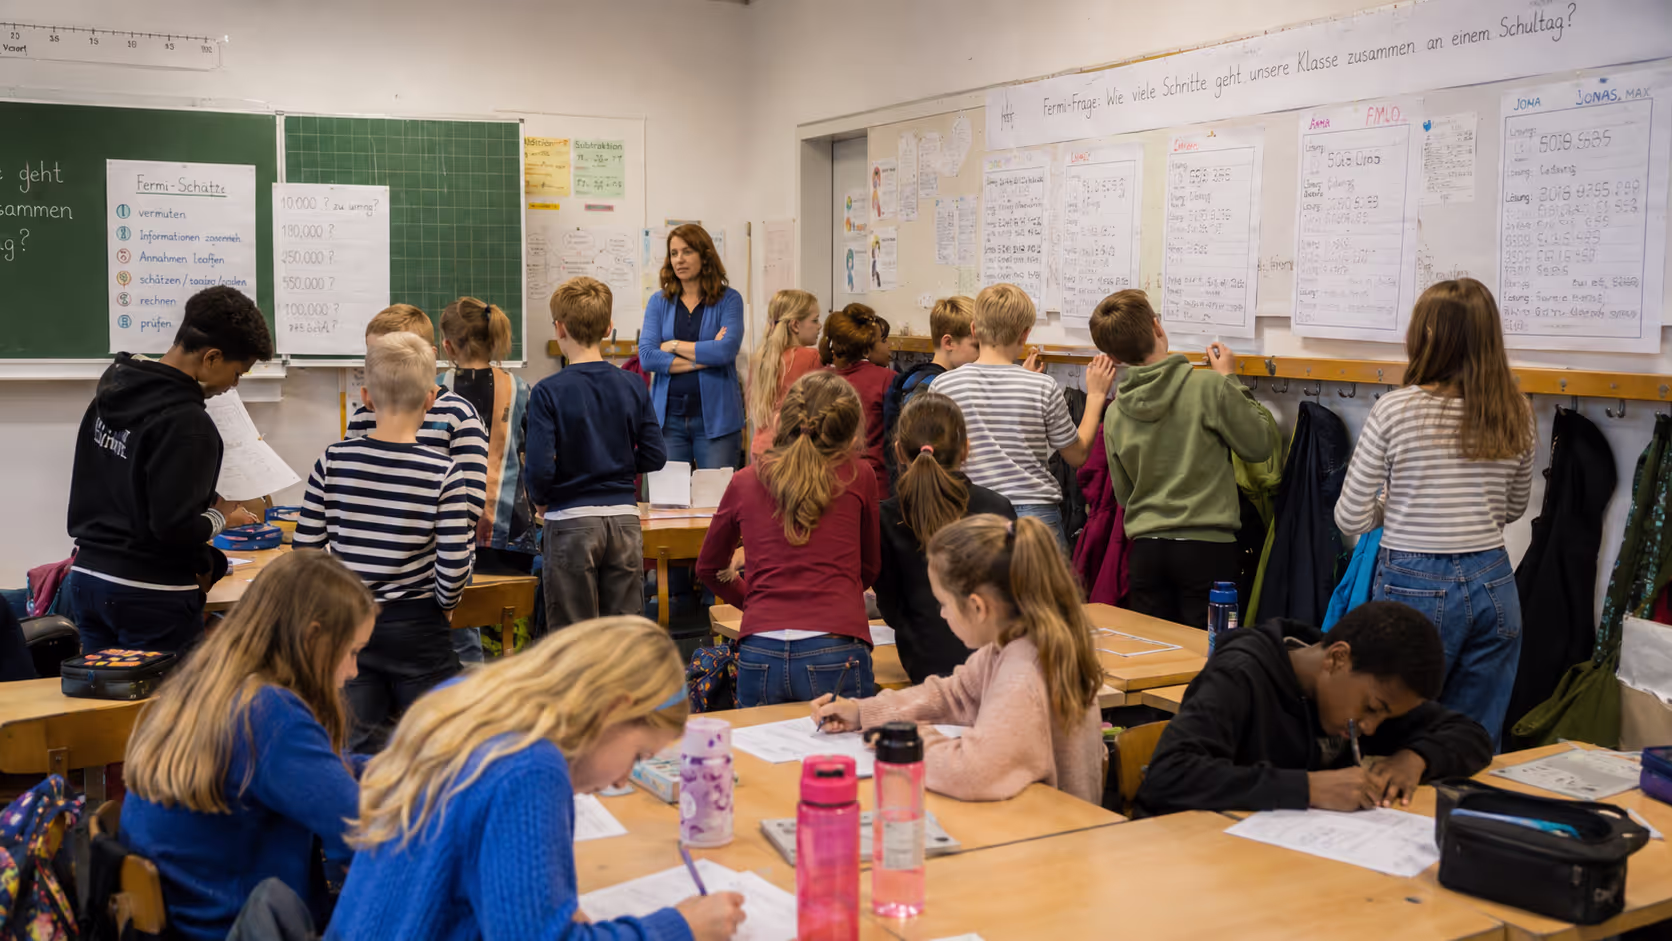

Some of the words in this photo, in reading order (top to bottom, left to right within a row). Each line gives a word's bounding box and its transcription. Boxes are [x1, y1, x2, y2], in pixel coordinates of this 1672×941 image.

[1044, 93, 1100, 119] Fermi-Frage:
[1106, 87, 1124, 106] Wie
[1132, 81, 1156, 101] viele
[1163, 72, 1207, 97] Schritte
[1215, 64, 1242, 99] geht
[1250, 62, 1290, 81] unsere
[1297, 50, 1339, 73] Klasse
[1347, 41, 1416, 65] zusammen
[1427, 36, 1443, 50] an
[1452, 29, 1490, 46] einem
[1500, 3, 1576, 42] Schultag?
[575, 140, 623, 150] Subtraktion
[19, 160, 64, 193] geht
[139, 208, 187, 219] vermuten
[140, 230, 200, 244] Informationen
[139, 251, 187, 264] Annahmen
[140, 294, 177, 305] rechnen
[141, 317, 172, 333] prüfen
